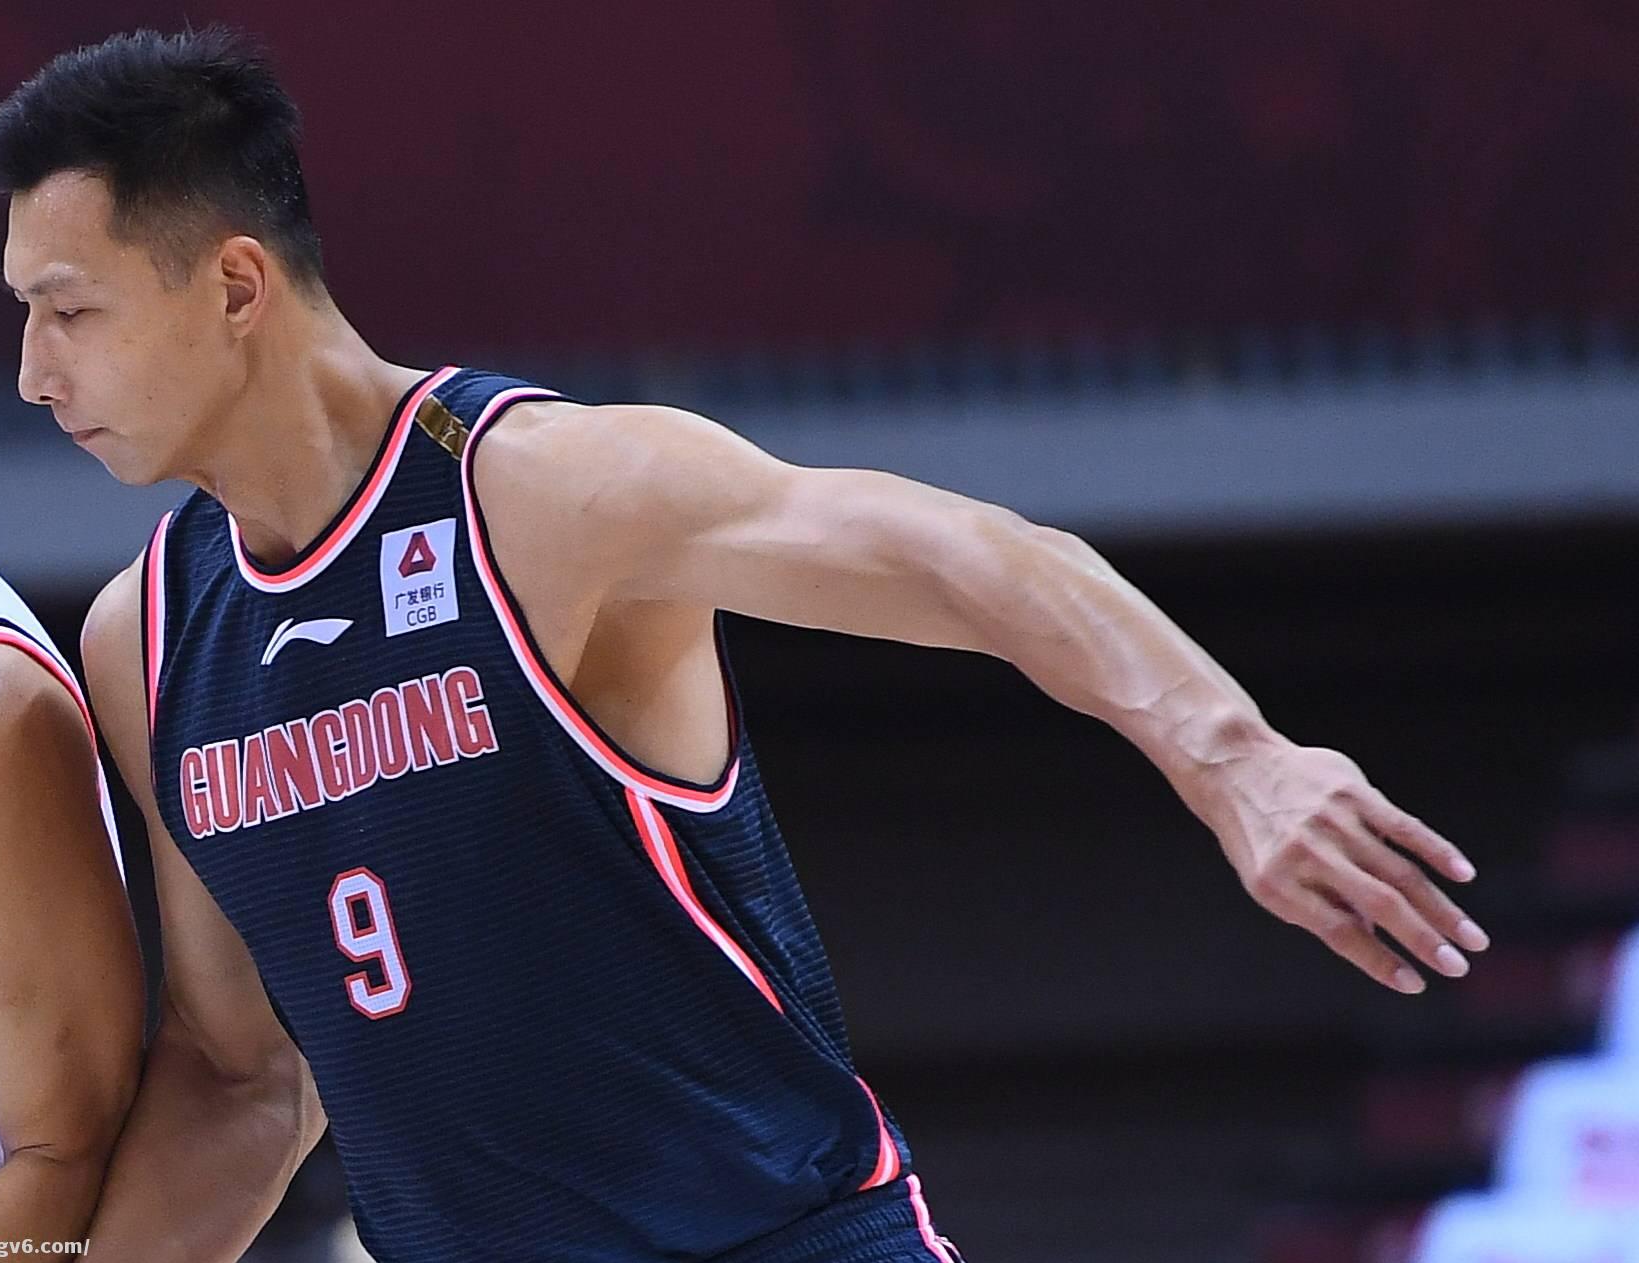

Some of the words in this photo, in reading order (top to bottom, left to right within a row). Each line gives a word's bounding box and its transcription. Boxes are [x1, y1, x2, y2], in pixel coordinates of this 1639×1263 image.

[394, 582, 444, 609] 广发银行
[406, 605, 437, 626] CGB
[179, 665, 500, 840] GUANGDONG
[326, 865, 414, 1022] 9
